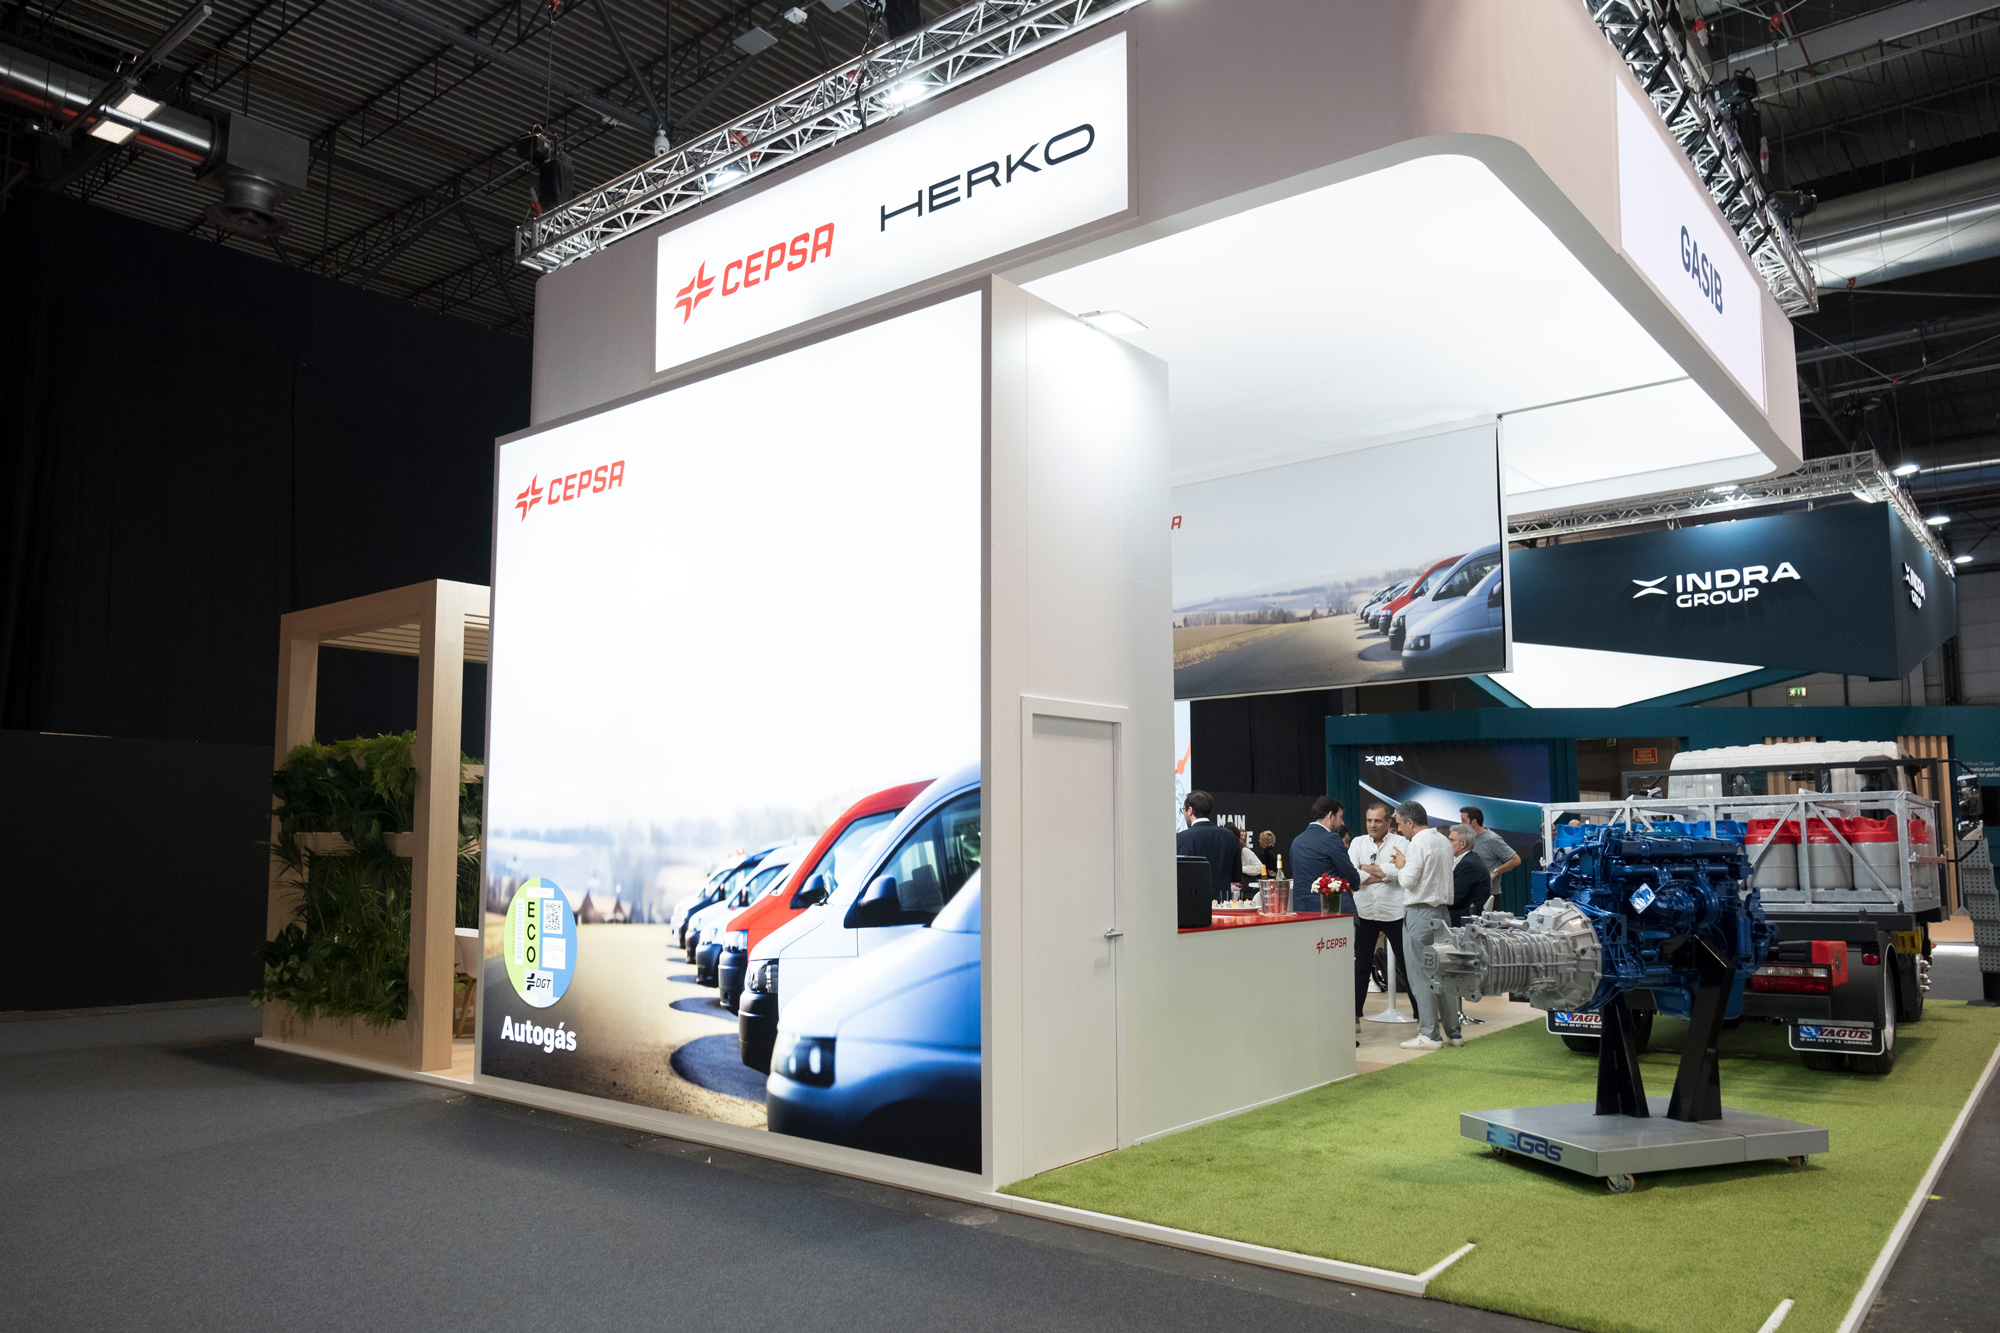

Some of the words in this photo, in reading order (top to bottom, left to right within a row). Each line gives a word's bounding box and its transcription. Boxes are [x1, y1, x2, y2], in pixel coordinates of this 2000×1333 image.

[880, 123, 1095, 232] HERKO
[721, 222, 835, 297] CEPSA
[1680, 225, 1723, 315] GASIB
[547, 460, 625, 505] CEPSA
[1676, 562, 1801, 594] INDRA
[1676, 587, 1759, 608] GROUP
[1216, 814, 1246, 830] MAIN
[1326, 937, 1347, 950] CEPSA
[535, 978, 552, 989] DGT
[501, 1016, 577, 1054] Autogás
